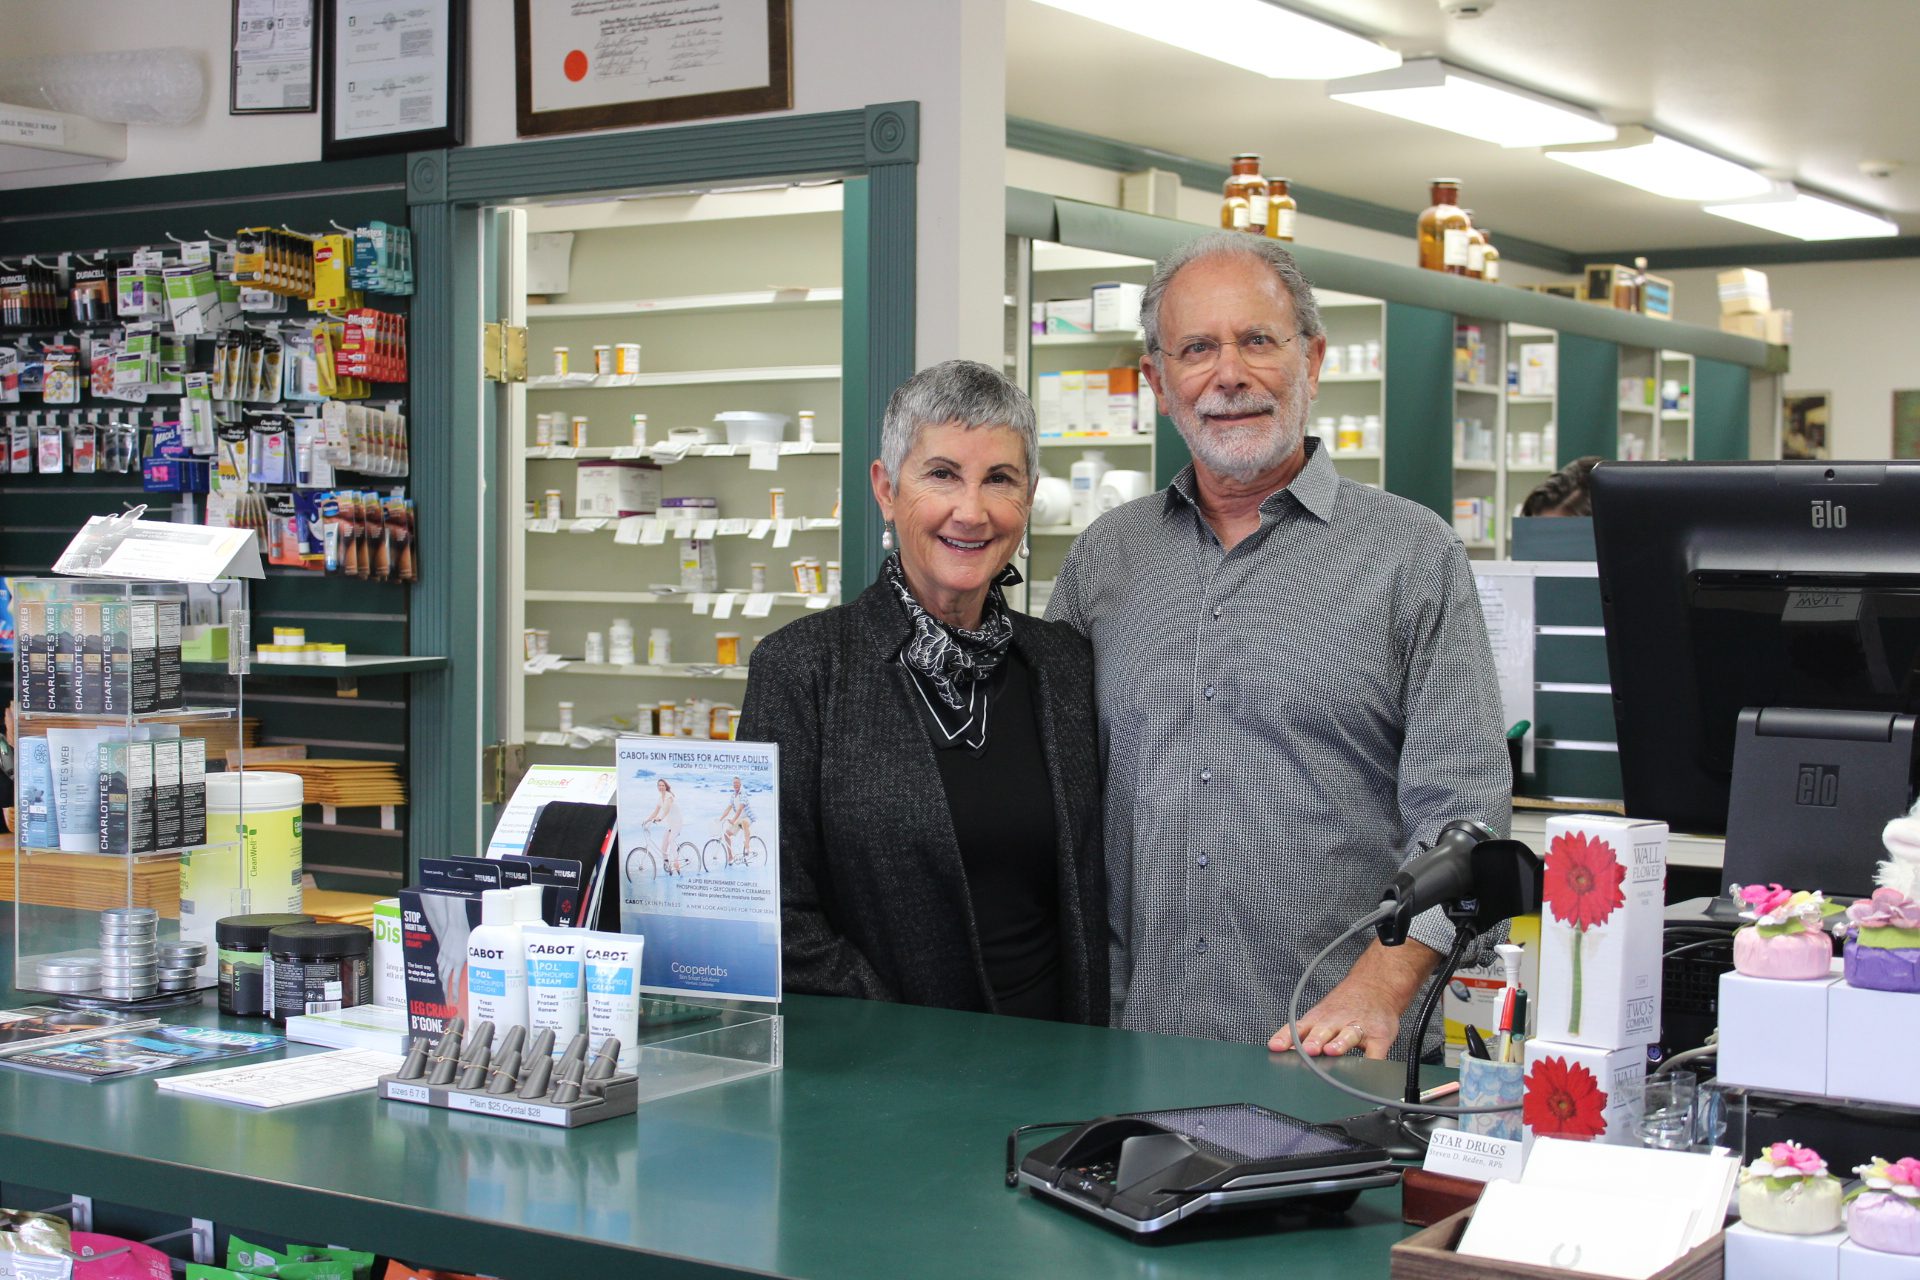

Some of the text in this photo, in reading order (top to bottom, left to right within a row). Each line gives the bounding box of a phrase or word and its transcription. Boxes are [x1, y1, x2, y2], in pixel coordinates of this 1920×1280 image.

[0, 275, 27, 285] DURACELL
[76, 269, 105, 280] DURACELL
[21, 607, 30, 709] CHARLOTTE'S WEB
[47, 607, 56, 710] CHARLOTTE'S WEB
[75, 607, 83, 710] CHARLOTTE'S WEB
[103, 633, 113, 710] CHARLOTTE'S
[650, 752, 667, 761] SKIN
[669, 753, 695, 761] FITNESS
[697, 753, 712, 762] FOR
[714, 754, 740, 763] ACTIVE
[742, 755, 769, 764] ADULTS
[59, 745, 70, 829] CHARLOTTE'S WEB
[100, 746, 109, 850] CHARLOTTE'S WEB
[1633, 847, 1661, 865] WALL
[1632, 865, 1661, 879] FLOWER
[404, 910, 421, 924] STOP
[376, 919, 401, 944] Dis
[469, 946, 504, 960] CABOT
[528, 944, 575, 955] CABOT
[586, 949, 628, 962] CABOT
[671, 962, 728, 977] Cooperlabs
[536, 977, 562, 985] CREAM
[409, 1000, 426, 1015] LEG
[1626, 1001, 1654, 1018] TWO'S
[411, 1015, 444, 1033] B'GONE
[1625, 1016, 1653, 1029] COMPANY
[391, 1087, 408, 1097] sizes
[415, 1089, 421, 1097] 7
[421, 1089, 426, 1099] 8
[469, 1098, 541, 1118] Plain $25 Crystal $28
[1432, 1133, 1506, 1156] STAR DRUGS
[1429, 1148, 1451, 1158] Steven
